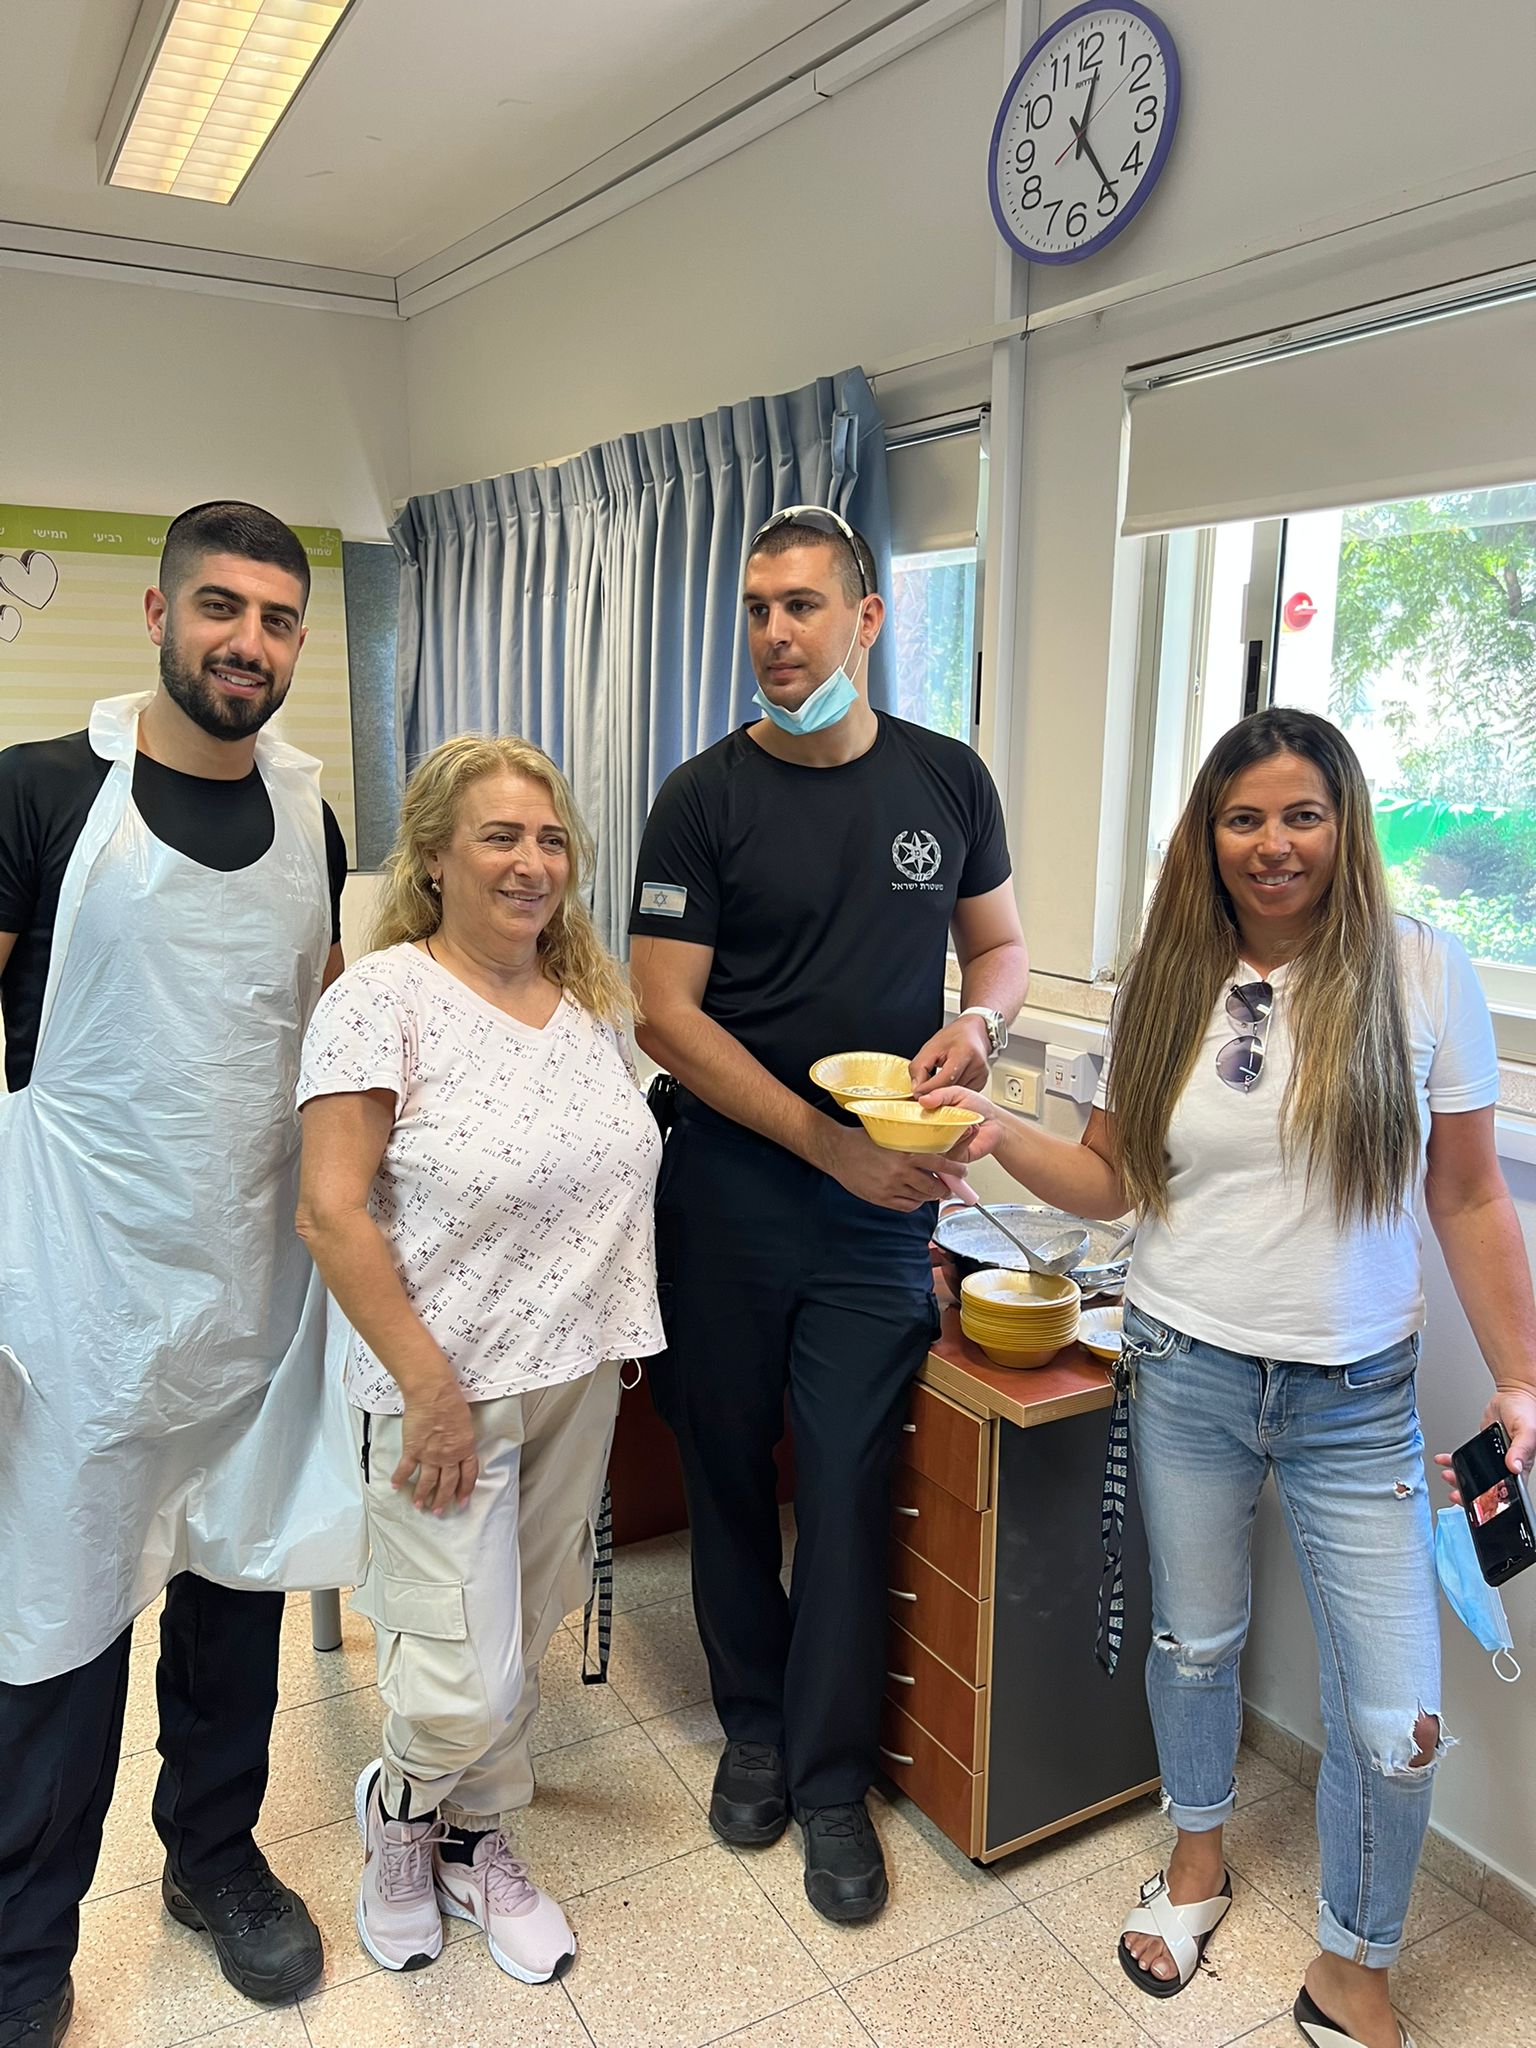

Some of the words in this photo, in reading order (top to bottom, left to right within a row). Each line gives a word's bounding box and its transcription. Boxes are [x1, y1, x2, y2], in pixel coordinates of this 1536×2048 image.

[1077, 31, 1105, 72] 12
[1118, 30, 1127, 66] 1
[1050, 53, 1070, 92] 11
[1129, 53, 1152, 94] 2
[1023, 93, 1053, 133] 10
[1134, 95, 1158, 134] 3
[1015, 138, 1036, 175] 9
[1120, 140, 1144, 176] 4
[1021, 174, 1042, 211] 8
[1097, 179, 1120, 217] 5
[1043, 199, 1064, 236] 7
[1066, 201, 1088, 238] 6
[33, 528, 68, 539] חמישי
[93, 533, 123, 543] רביעי
[891, 882, 918, 891] ישראל
[340, 1015, 370, 1042] TOMMY
[322, 1043, 349, 1072] TOMMY
[436, 1067, 455, 1098] TOMMY
[445, 1071, 467, 1102] HILFIGER
[511, 1102, 530, 1129] TOMMY
[595, 1119, 630, 1136] HILFIGER
[600, 1111, 634, 1126] TOMMY
[444, 1115, 471, 1146] HILFIGER
[456, 1121, 483, 1152] TOMMY
[547, 1132, 577, 1151] TOMMY
[481, 1147, 522, 1167] HILFIGER
[491, 1136, 529, 1155] TOMMY
[583, 1137, 602, 1166] TOMMY
[591, 1143, 612, 1173] HILFIGER
[416, 1164, 449, 1186] TOMMY
[422, 1153, 459, 1176] HILFIGER
[526, 1150, 551, 1184] HILFIGER
[538, 1157, 561, 1189] TOMMY
[457, 1169, 485, 1202] TOMMY
[469, 1175, 498, 1209] HILFIGER
[566, 1174, 591, 1193] TOMMY
[610, 1169, 636, 1190] TOMMY
[414, 1188, 431, 1216] TOMMY
[496, 1204, 528, 1221] TOMMY
[505, 1193, 537, 1210] HILFIGER
[586, 1187, 611, 1218] HILFIGER
[595, 1194, 618, 1224] TOMMY
[432, 1215, 464, 1239] HILFIGER
[439, 1207, 472, 1230] TOMMY
[530, 1203, 556, 1234] TOMMY
[539, 1208, 564, 1240] HILFIGER
[408, 1236, 432, 1264] TOMMY
[470, 1221, 497, 1250] HILFIGER
[481, 1226, 508, 1257] TOMMY
[561, 1236, 592, 1257] TOMMY
[568, 1225, 599, 1246] HILFIGER
[417, 1243, 442, 1273] HILFIGER
[503, 1254, 534, 1272] HILFIGER
[512, 1243, 541, 1261] TOMMY
[442, 1268, 473, 1291] TOMMY
[450, 1258, 482, 1280] HILFIGER
[537, 1256, 563, 1289] HILFIGER
[549, 1263, 573, 1296] TOMMY
[476, 1274, 503, 1307] TOMMY
[486, 1279, 513, 1314] HILFIGER
[614, 1275, 640, 1297] TOMMY
[418, 1287, 445, 1318] HILFIGER
[426, 1295, 453, 1326] TOMMY
[518, 1297, 551, 1319] HILFIGER
[456, 1314, 488, 1334] TOMMY
[510, 1308, 541, 1329] TOMMY
[544, 1312, 569, 1344] TOMMY
[625, 1317, 653, 1339] TOMMY
[448, 1325, 480, 1344] HILFIGER
[483, 1327, 511, 1358] HILFIGER
[494, 1333, 520, 1363] TOMMY
[554, 1317, 579, 1350] HILFIGER
[515, 1361, 549, 1379] HILFIGER
[524, 1351, 556, 1370] TOMMY
[462, 1366, 494, 1385] HILFIGER
